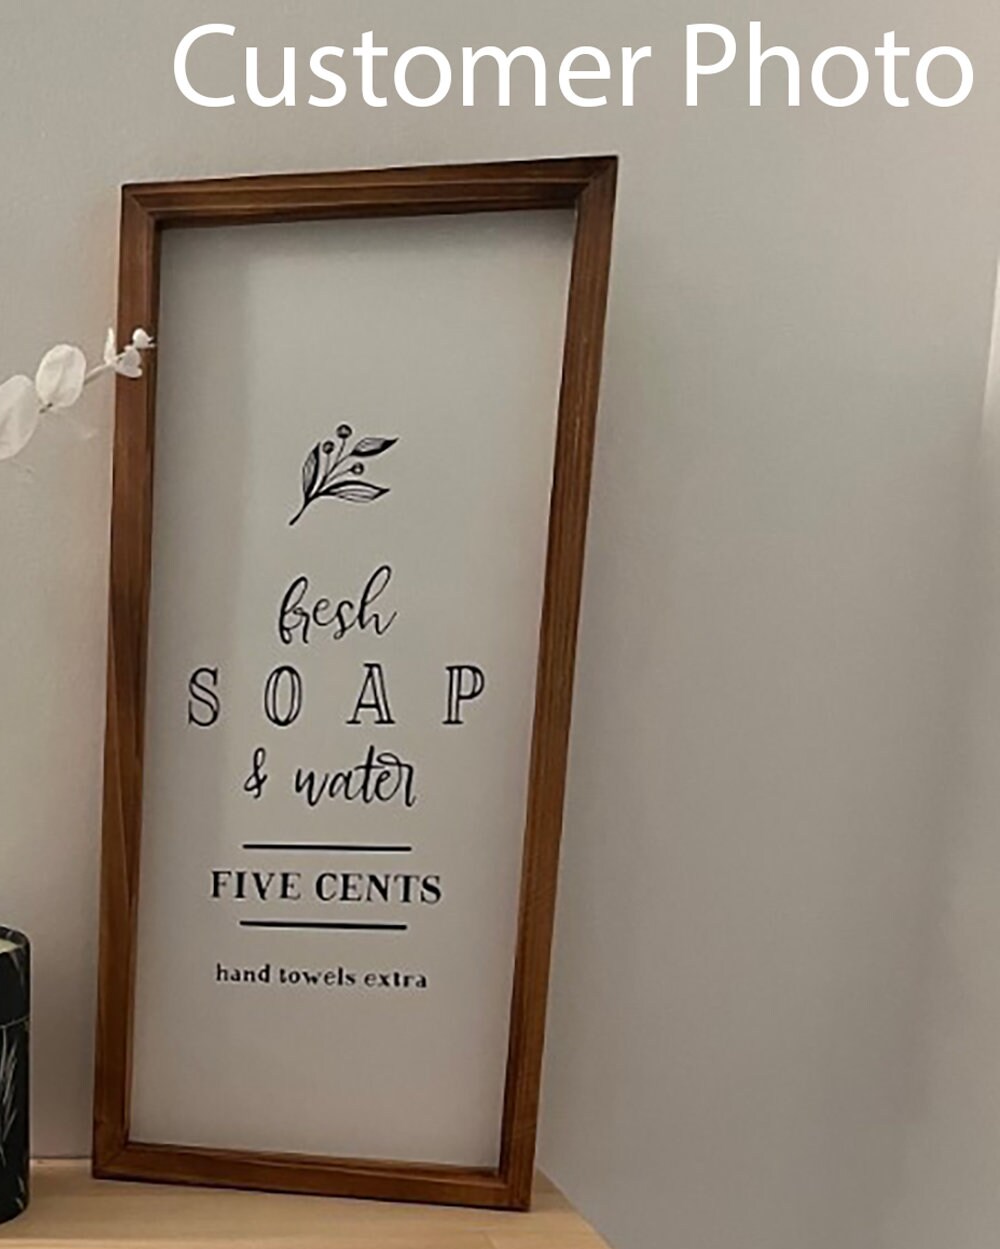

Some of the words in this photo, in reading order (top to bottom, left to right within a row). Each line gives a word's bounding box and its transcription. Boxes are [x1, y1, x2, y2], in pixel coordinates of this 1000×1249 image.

[278, 564, 398, 645] fresh
[187, 662, 486, 727] SOAP
[243, 746, 268, 800] &
[294, 744, 418, 808] water
[210, 870, 302, 901] FIVE
[314, 872, 442, 905] CENTS
[215, 962, 271, 984] hand
[279, 966, 357, 988] towels
[363, 970, 428, 990] extra
